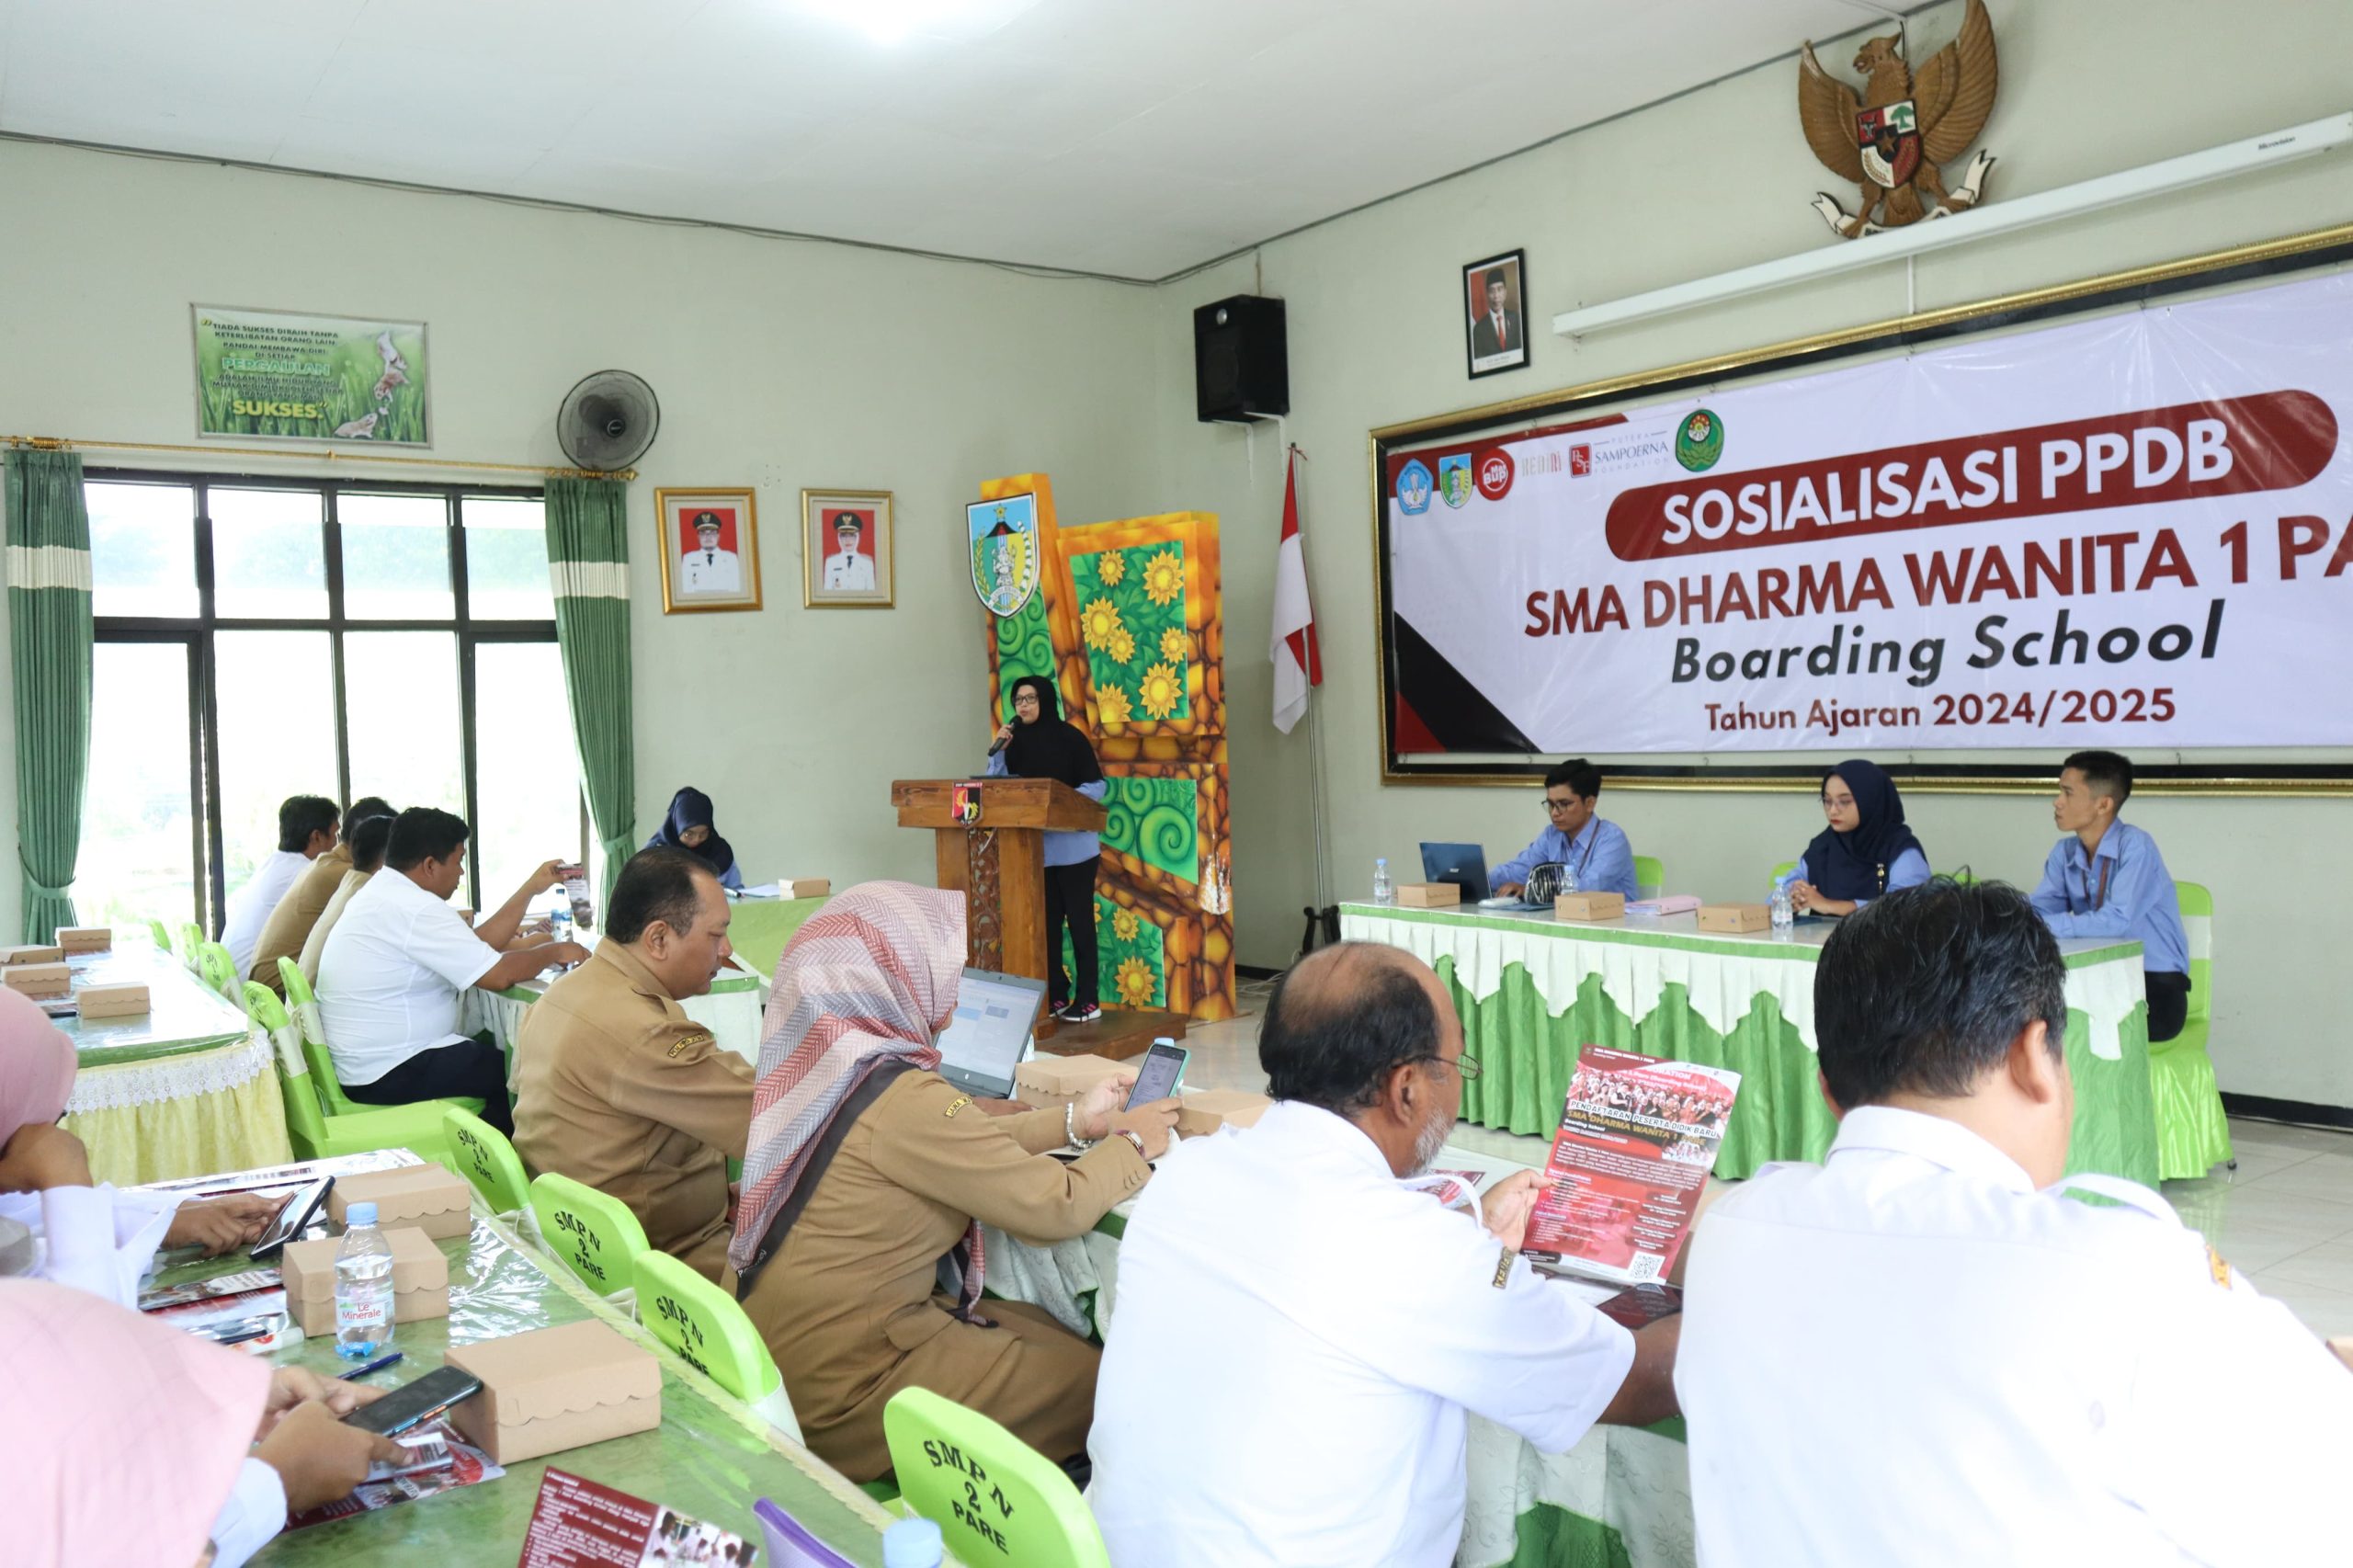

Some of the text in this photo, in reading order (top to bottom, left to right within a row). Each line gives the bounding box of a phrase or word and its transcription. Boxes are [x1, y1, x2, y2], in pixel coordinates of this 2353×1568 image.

[215, 332, 278, 342] KETERLIBATAN
[280, 336, 313, 345] ORANG
[222, 342, 257, 350] PANDAI
[243, 325, 275, 335] SUKSES
[311, 330, 339, 339] TANPA
[222, 357, 330, 376] PERGAULAN
[1595, 441, 1669, 463] SAMPOERNA
[1661, 418, 2234, 545] SOSIALISASI PPDB
[1524, 588, 1630, 639] SMA
[1643, 558, 1896, 628] DHARMA
[1904, 528, 2199, 607] WANITA
[2221, 520, 2250, 585] 1
[1671, 598, 2227, 687] Boarding School
[1704, 687, 2178, 738] Tahun Ajaran 2024/2025
[1566, 1109, 1587, 1122] SMA
[1589, 1115, 1631, 1132] DHARMA
[1632, 1122, 1671, 1140] WANITA
[1570, 1100, 1718, 1138] PENDAFTARAN PESERTA DIDIK BARU
[554, 1210, 601, 1253] SMP N
[578, 1237, 590, 1259] 2
[574, 1252, 607, 1280] PARE
[342, 1309, 381, 1321] Minerale
[358, 1302, 369, 1312] Le
[656, 1295, 704, 1348] SMP N
[680, 1328, 694, 1354] 2
[923, 1439, 1015, 1519] SMP N
[964, 1481, 982, 1514] 2
[951, 1500, 1009, 1555] PARE
